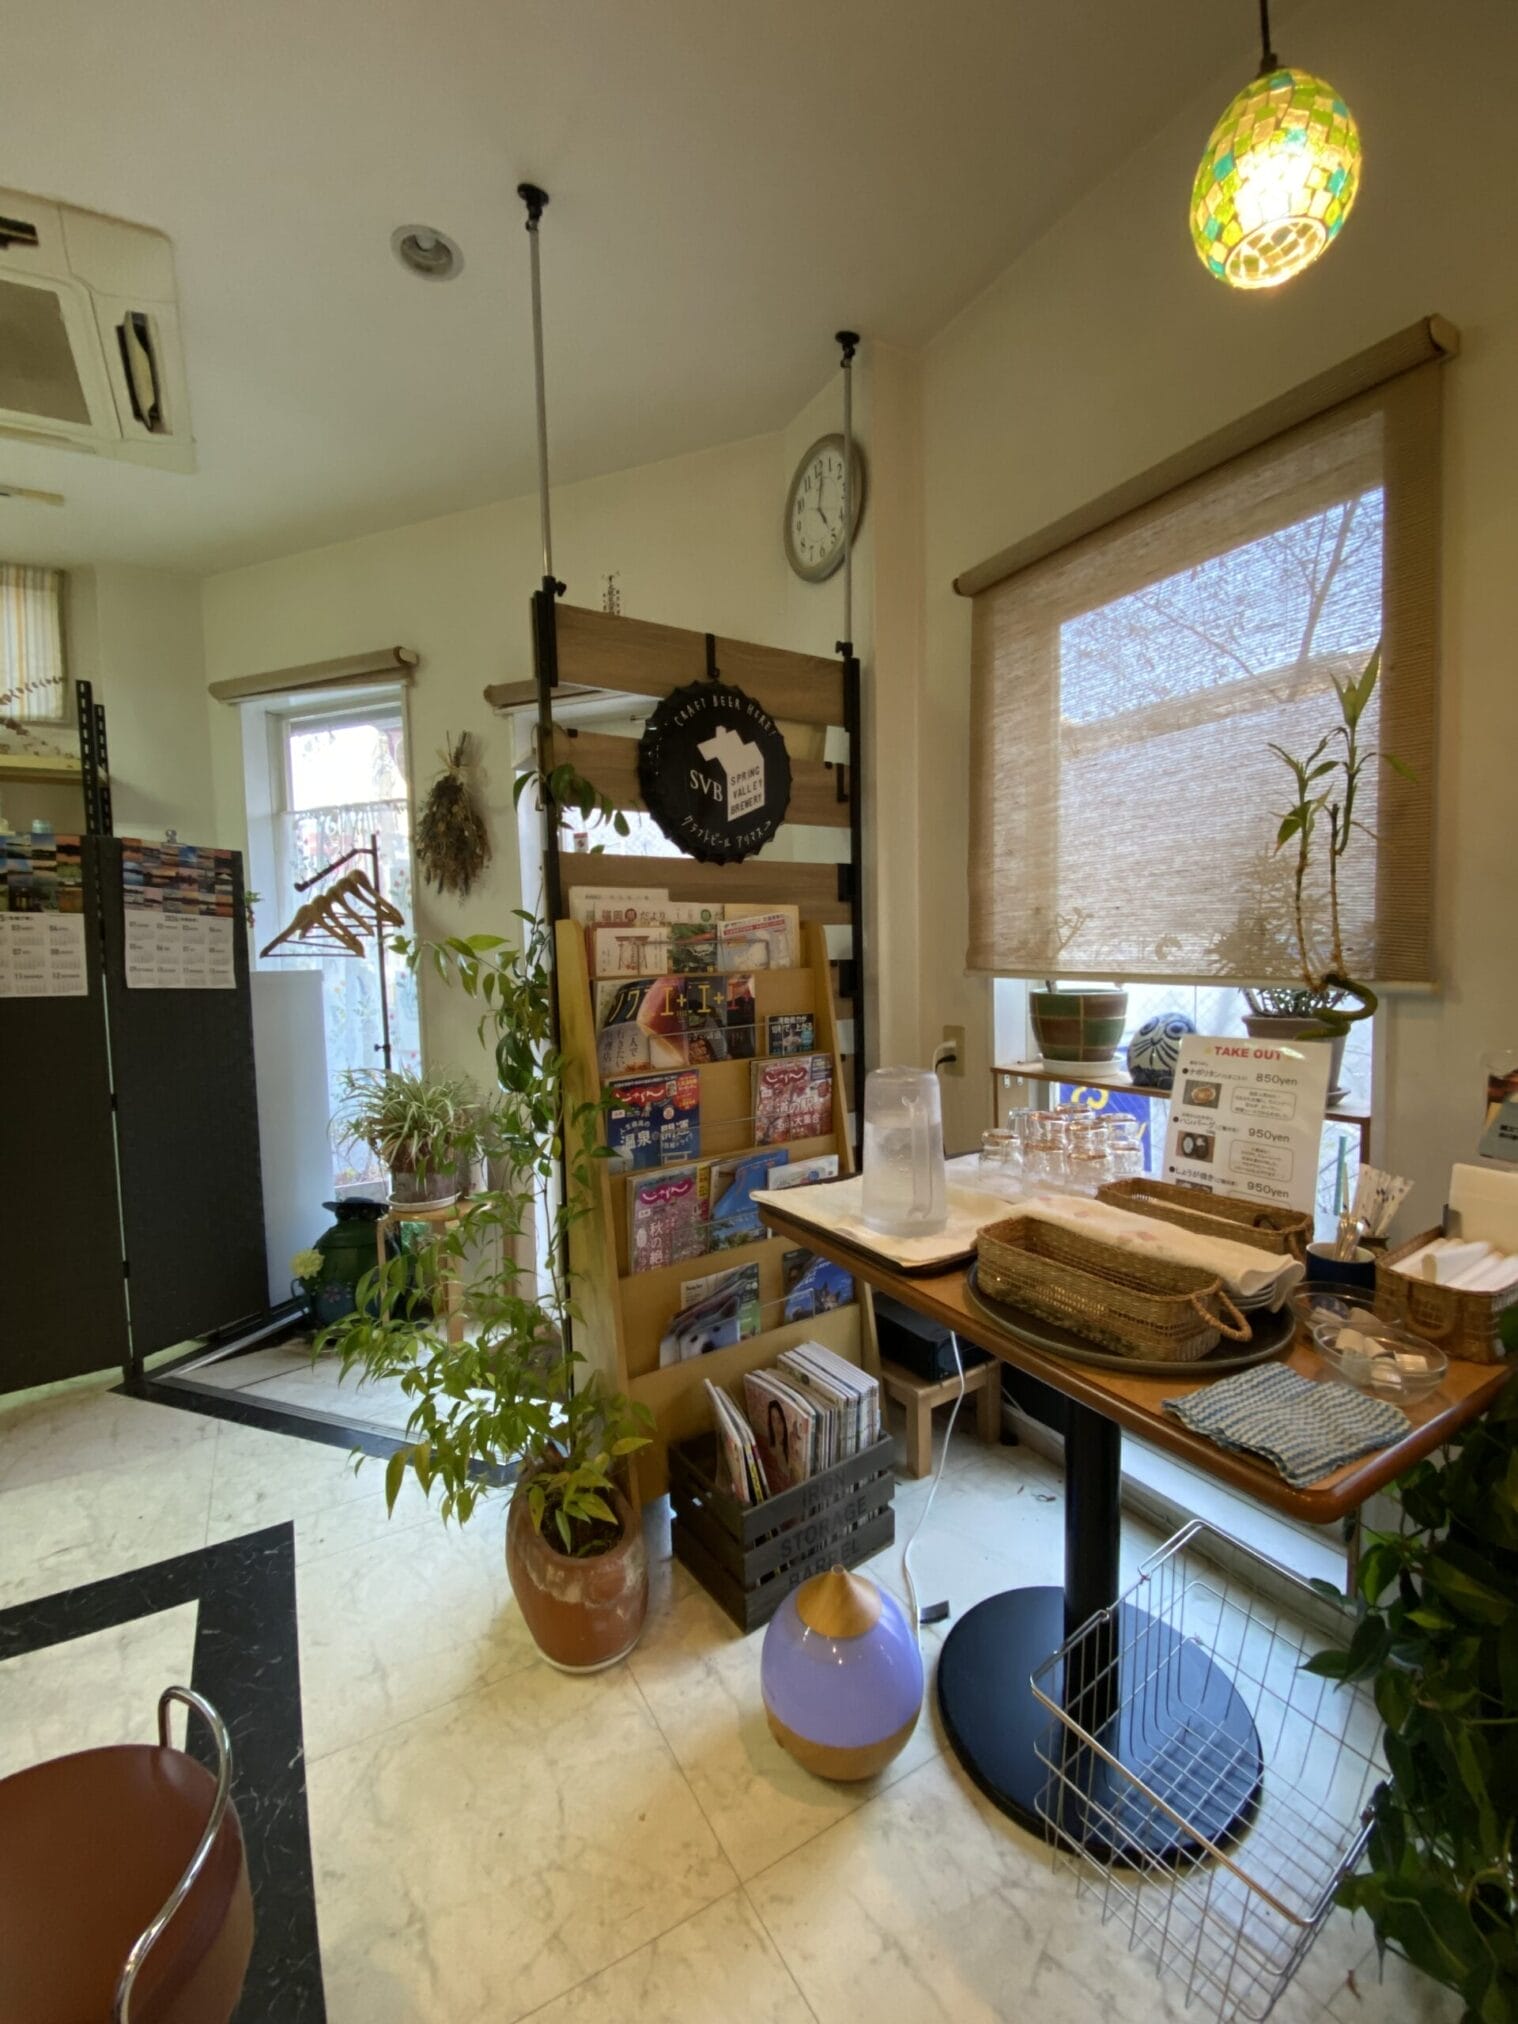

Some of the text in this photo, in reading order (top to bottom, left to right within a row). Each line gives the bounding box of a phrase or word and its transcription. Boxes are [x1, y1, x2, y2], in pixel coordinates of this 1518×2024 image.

[712, 695, 741, 710] BEER
[730, 765, 761, 786] SPRING
[689, 769, 724, 803] SVB
[732, 779, 763, 799] VALLEY
[730, 793, 763, 816] BREWERY
[1214, 1046, 1281, 1061] TAKE OUT
[1256, 1072, 1298, 1087] 850yen
[1248, 1127, 1290, 1143] 950yen
[1247, 1181, 1289, 1198] 950yen
[781, 1495, 867, 1558] STORAGE
